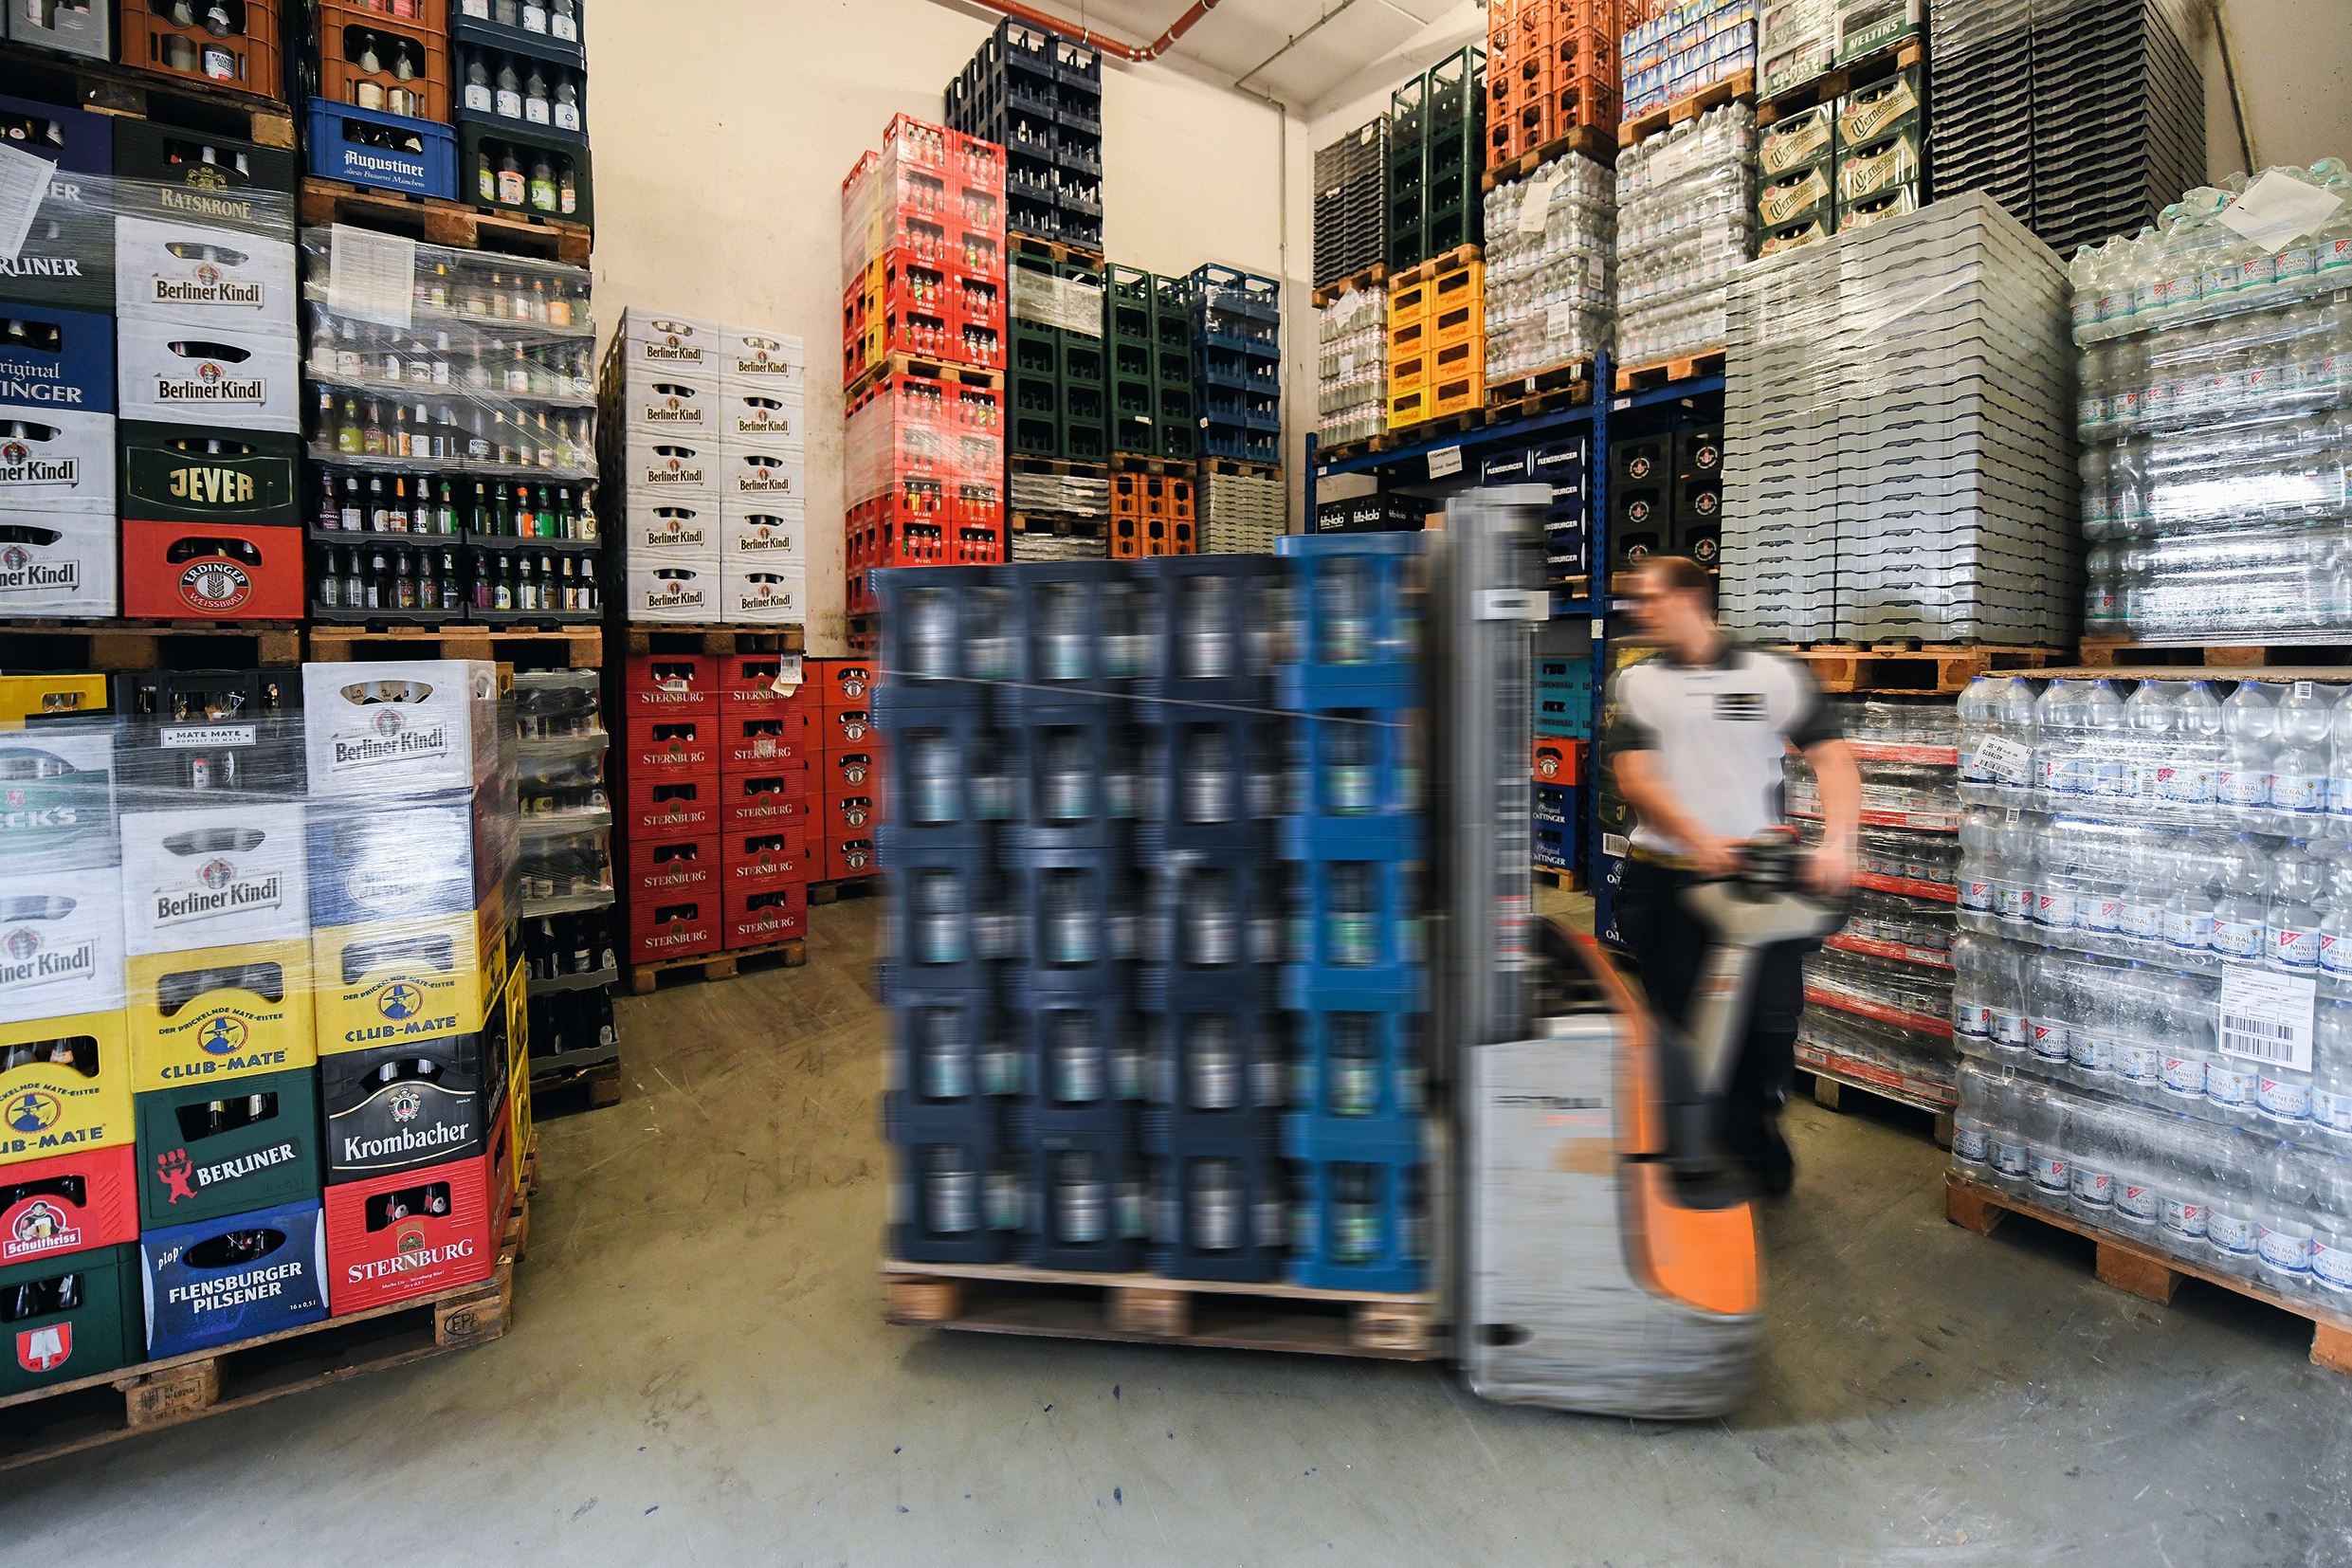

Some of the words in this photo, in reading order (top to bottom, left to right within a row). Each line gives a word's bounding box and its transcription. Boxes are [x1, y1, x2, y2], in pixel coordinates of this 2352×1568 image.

[1850, 21, 1899, 48] VELTINS
[344, 150, 424, 177] Augustiner
[161, 189, 252, 220] RATSKRONE
[156, 281, 217, 301] Berliner
[219, 283, 260, 302] Kindl
[647, 346, 679, 359] Berliner
[680, 348, 701, 359] Kindl
[738, 361, 767, 373] Berliner
[768, 362, 788, 373] Kindl
[159, 380, 219, 398] Berliner
[221, 380, 262, 398] Kindl
[647, 409, 679, 421] Berliner
[680, 409, 702, 420] Kindl
[739, 421, 767, 431] Berliner
[768, 421, 789, 431] Kindl
[1538, 451, 1577, 465] FLENSBURGER
[27, 461, 74, 481] Kindl
[647, 471, 679, 483] Berliner
[680, 469, 702, 482] Kindl
[1486, 462, 1523, 475] FLENSBURGER
[169, 467, 254, 503] JEVER
[739, 480, 768, 491] Berliner
[769, 479, 789, 490] Kindl
[648, 533, 680, 544] Berliner
[680, 531, 702, 543] Kindl
[740, 538, 769, 550] Berliner
[770, 538, 790, 549] Kindl
[27, 563, 74, 584] Kindl
[185, 564, 245, 584] ERDINGER
[190, 592, 244, 608] WEISSBRÄU
[648, 595, 680, 607] Berliner
[680, 592, 702, 604] Kindl
[741, 598, 770, 610] Berliner
[770, 595, 791, 607] Kindl
[641, 691, 704, 703] STERNBURG
[336, 738, 399, 763] Berliner
[401, 726, 444, 752] Kindl
[643, 752, 705, 764] STERNBURG
[2225, 783, 2260, 793] MINERAL
[643, 811, 705, 826] STERNBURG
[736, 804, 793, 818] STERNBURG
[737, 861, 793, 877] STERNBURG
[644, 870, 706, 887] STERNBURG
[158, 892, 228, 920] Berliner
[230, 878, 278, 905] Kindl
[738, 916, 794, 935] STERNBURG
[645, 930, 707, 948] STERNBURG
[38, 944, 90, 975] Kindl
[178, 1007, 230, 1033] PRICKELNDE
[232, 1007, 283, 1021] MATE-EISTEE
[344, 1016, 457, 1043] CLUB-MATE
[160, 1049, 285, 1080] CLUB-MATE
[43, 1083, 100, 1097] MATE-EISTEE
[2268, 1092, 2305, 1105] MINERAL
[2271, 1099, 2300, 1109] WASSER
[344, 1121, 469, 1162] Krombacher
[196, 1143, 297, 1187] BERLINER
[8, 1233, 77, 1255] Schultheiss
[2262, 1239, 2298, 1257] MINERAL
[348, 1238, 475, 1285] STERNBURG
[169, 1262, 302, 1304] FLENSBURGER
[193, 1282, 283, 1314] PILSENER
[290, 1303, 298, 1311] 16
[302, 1301, 312, 1309] 0,5
